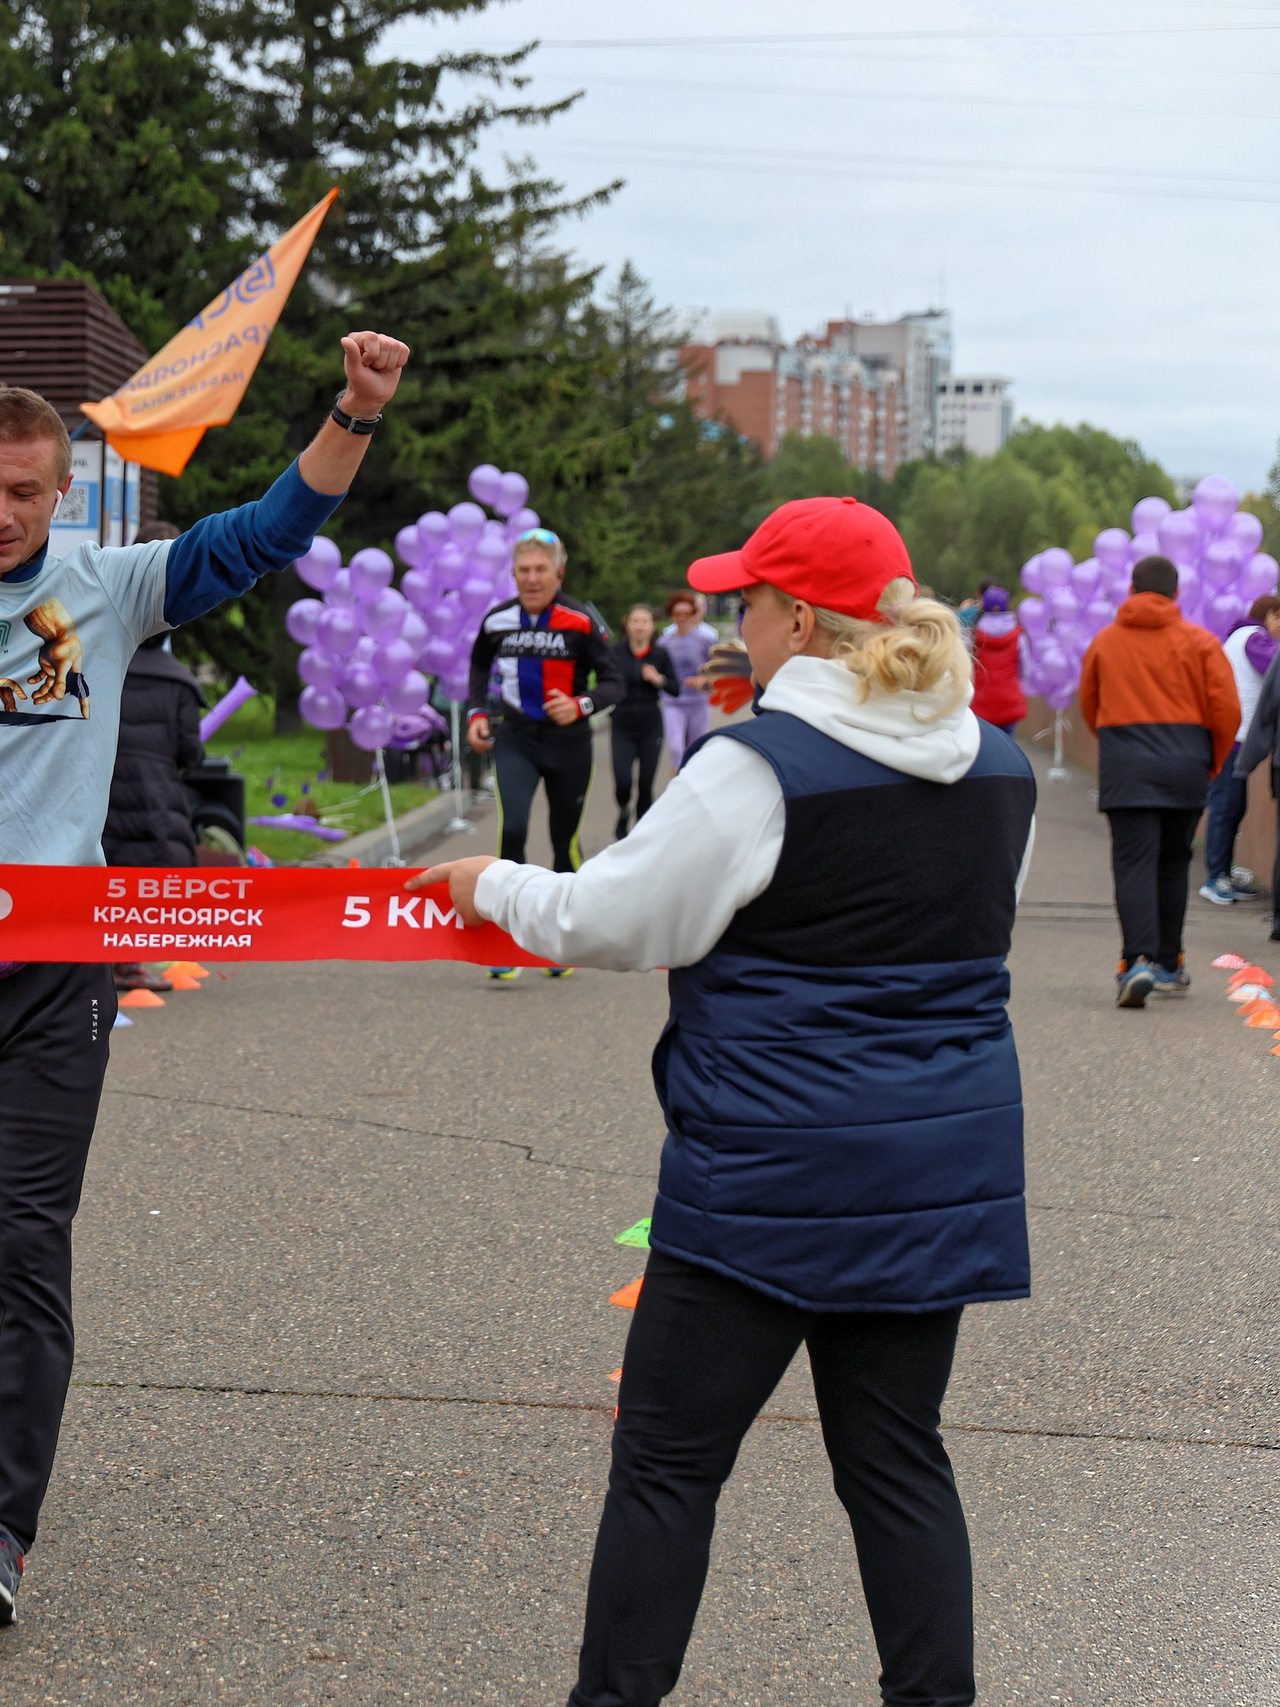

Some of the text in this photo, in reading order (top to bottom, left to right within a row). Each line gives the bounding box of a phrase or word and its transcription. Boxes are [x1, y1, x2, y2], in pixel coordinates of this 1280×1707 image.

[106, 874, 254, 899] 5 ВЁРСТ
[93, 906, 263, 926] КРАСНОЯРСК
[341, 895, 465, 930] 5 КМ
[103, 932, 252, 948] НАБЕРЕЖНАЯ
[91, 999, 99, 1041] KIPSTA
